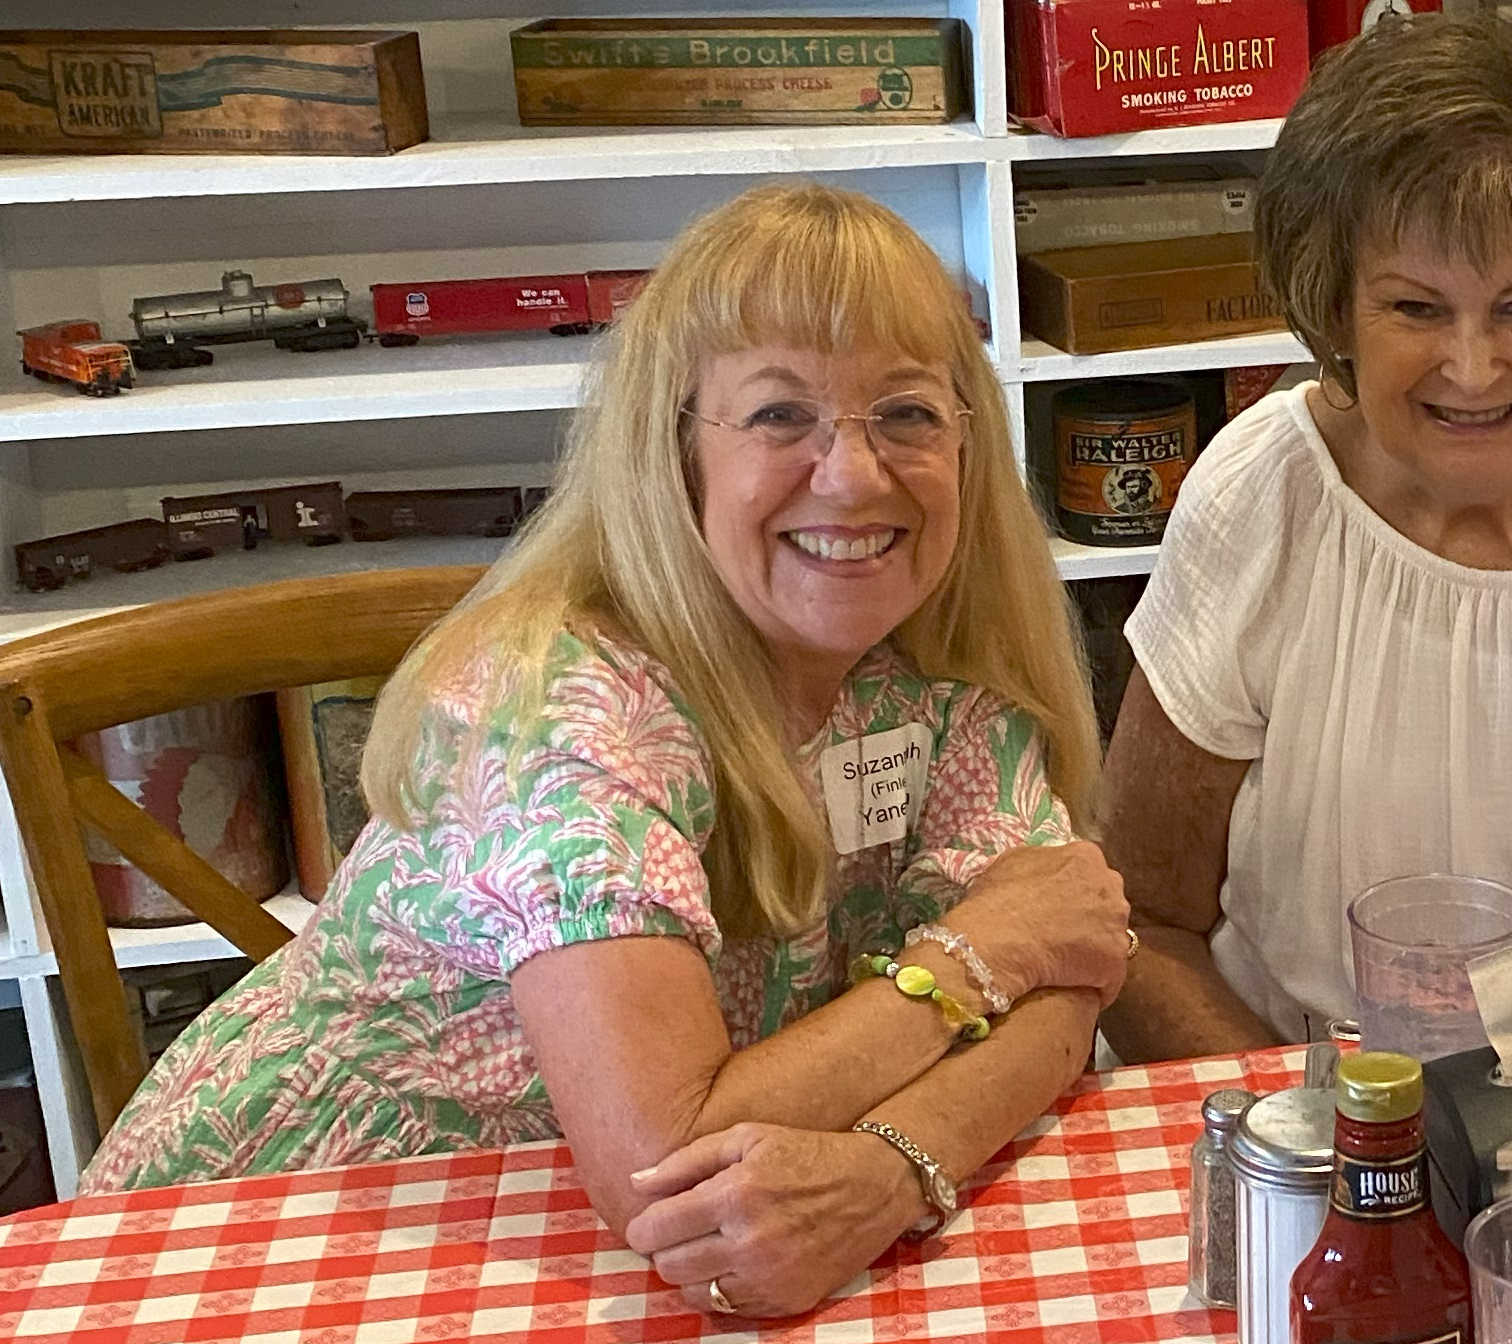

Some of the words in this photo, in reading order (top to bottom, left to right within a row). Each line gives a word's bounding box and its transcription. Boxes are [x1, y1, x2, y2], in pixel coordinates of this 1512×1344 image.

[687, 39, 895, 65] Brookfield
[1091, 27, 1182, 90] PRINCE
[1193, 23, 1276, 75] ALBERT
[62, 61, 147, 98] KRAFT
[782, 77, 833, 91] CHEESE
[1121, 89, 1187, 108] SMOKING
[1193, 83, 1254, 101] TOBACCO
[66, 105, 151, 128] AMERICAN
[1075, 435, 1102, 450] SIR
[1111, 433, 1182, 450] WALTER
[1076, 443, 1182, 463] RALEIGH
[1359, 1168, 1419, 1198] HOUSE
